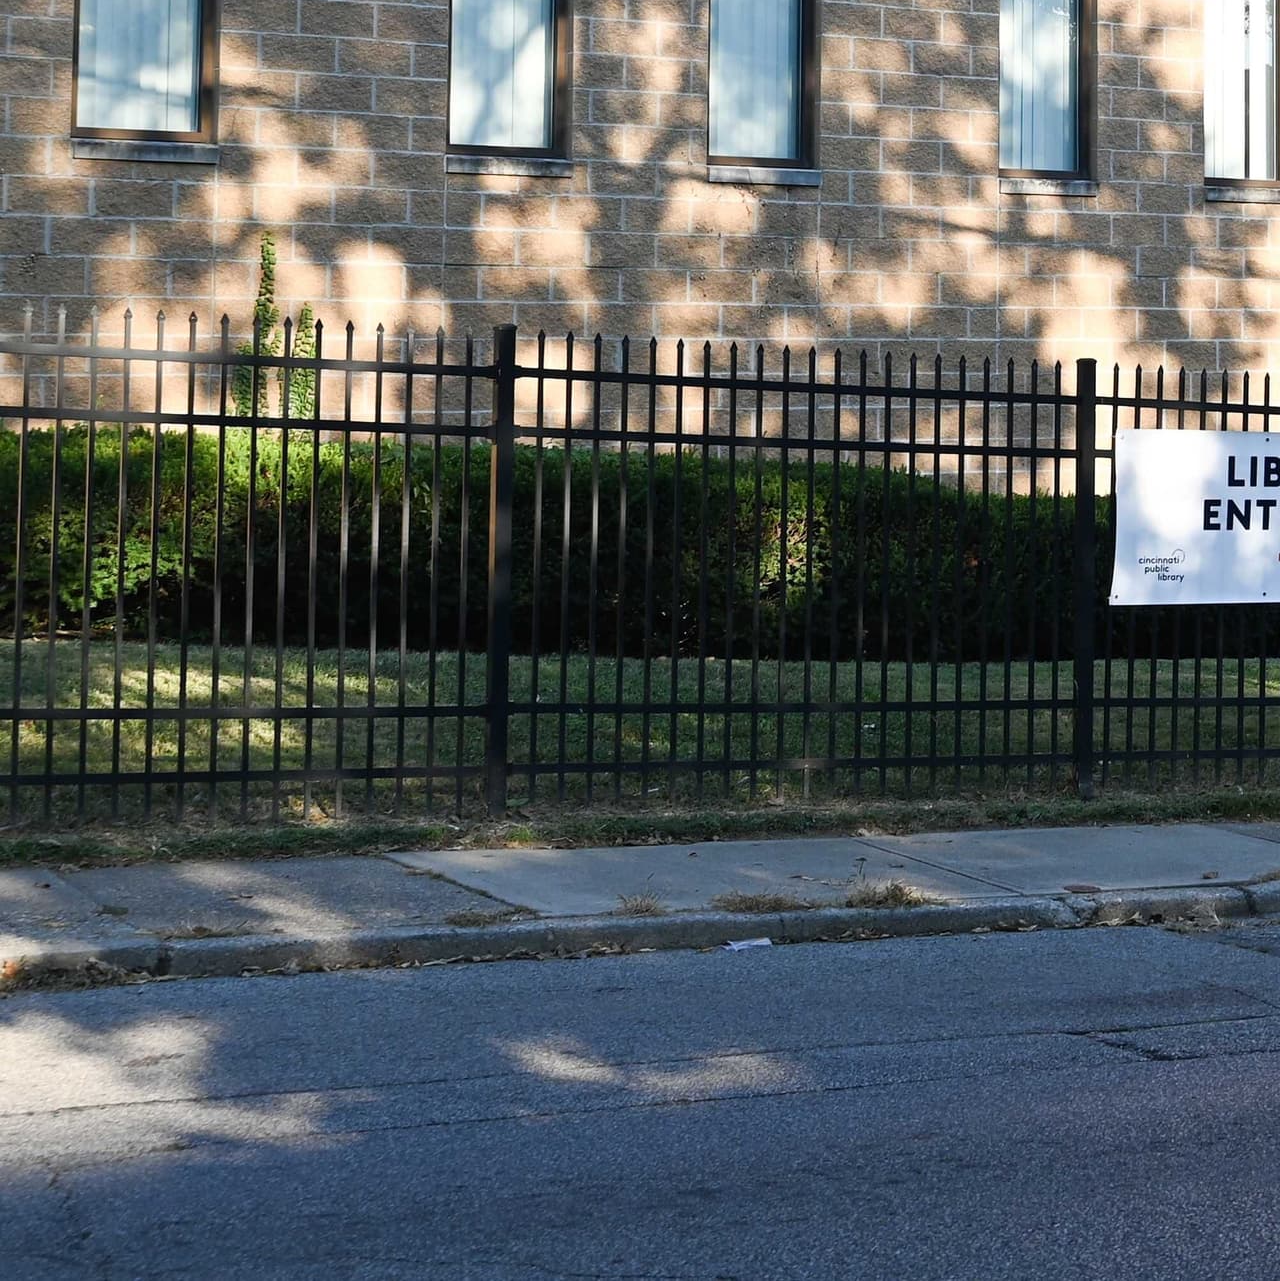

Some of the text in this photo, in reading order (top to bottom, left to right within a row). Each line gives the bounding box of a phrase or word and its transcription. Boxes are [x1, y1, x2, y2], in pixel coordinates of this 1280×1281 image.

[1138, 555, 1179, 564] cincinnati
[1144, 565, 1169, 574] public
[1157, 573, 1184, 583] library
